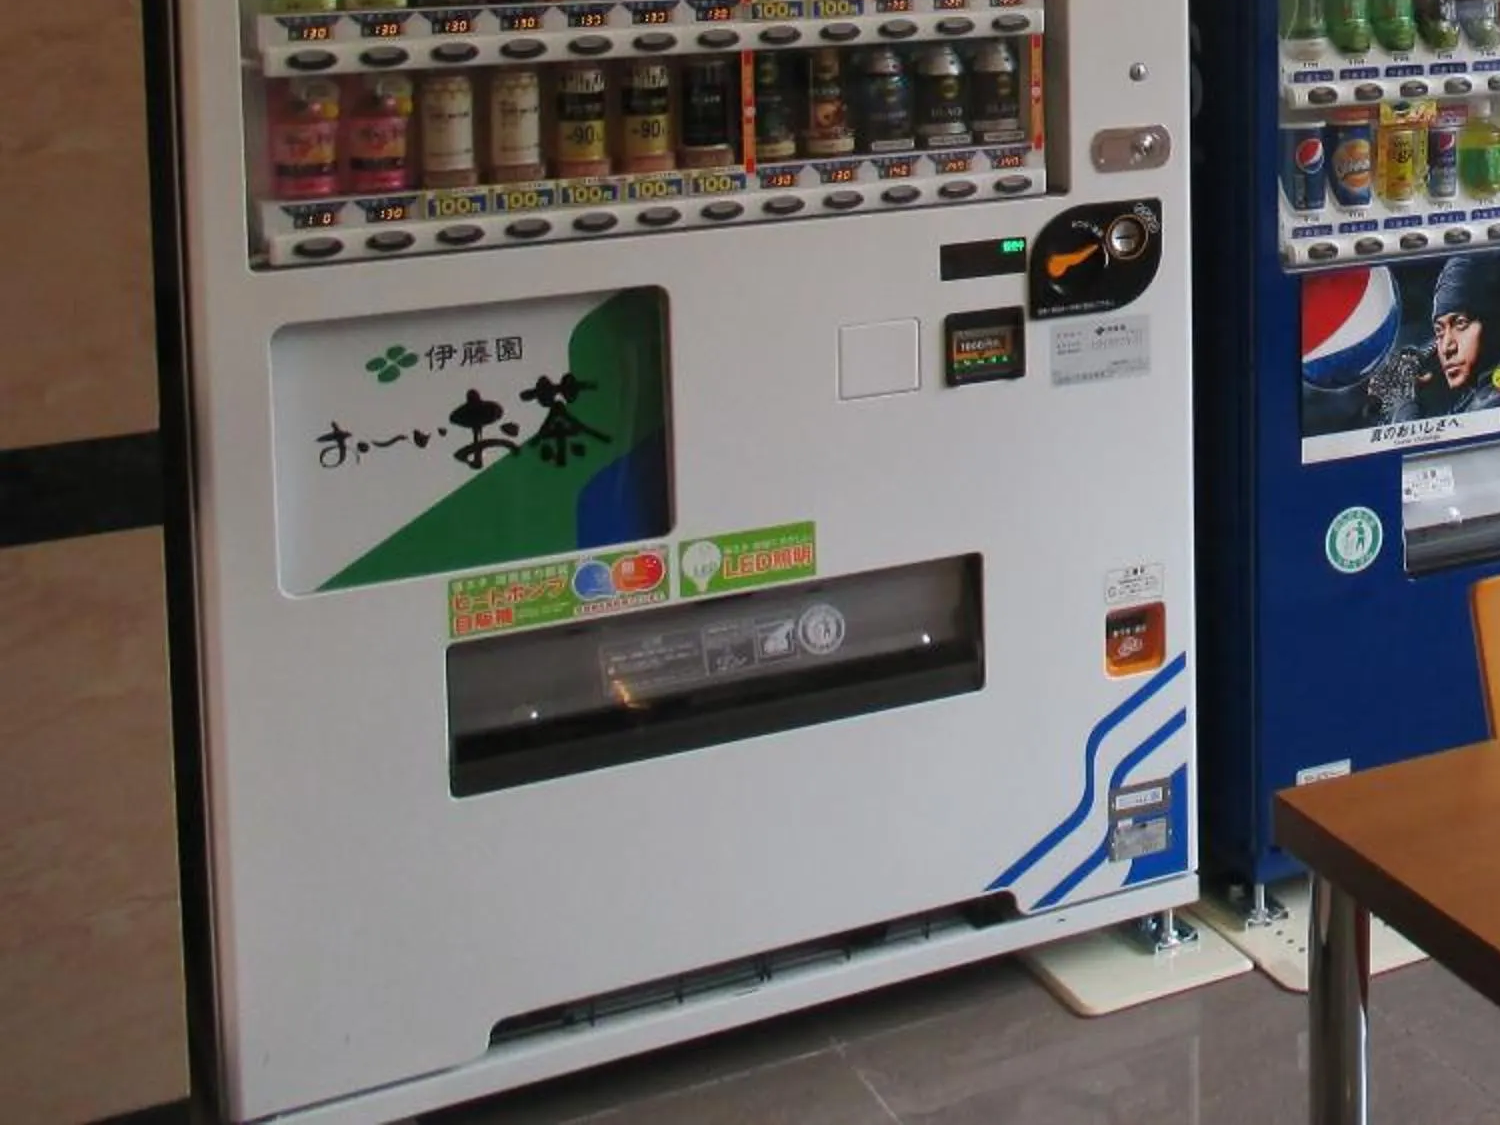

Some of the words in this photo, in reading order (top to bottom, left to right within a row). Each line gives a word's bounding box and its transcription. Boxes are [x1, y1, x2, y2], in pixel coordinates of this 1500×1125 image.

[309, 211, 331, 224] 10
[424, 335, 525, 371] 伊藤園
[451, 576, 568, 612] ヒートポンプ
